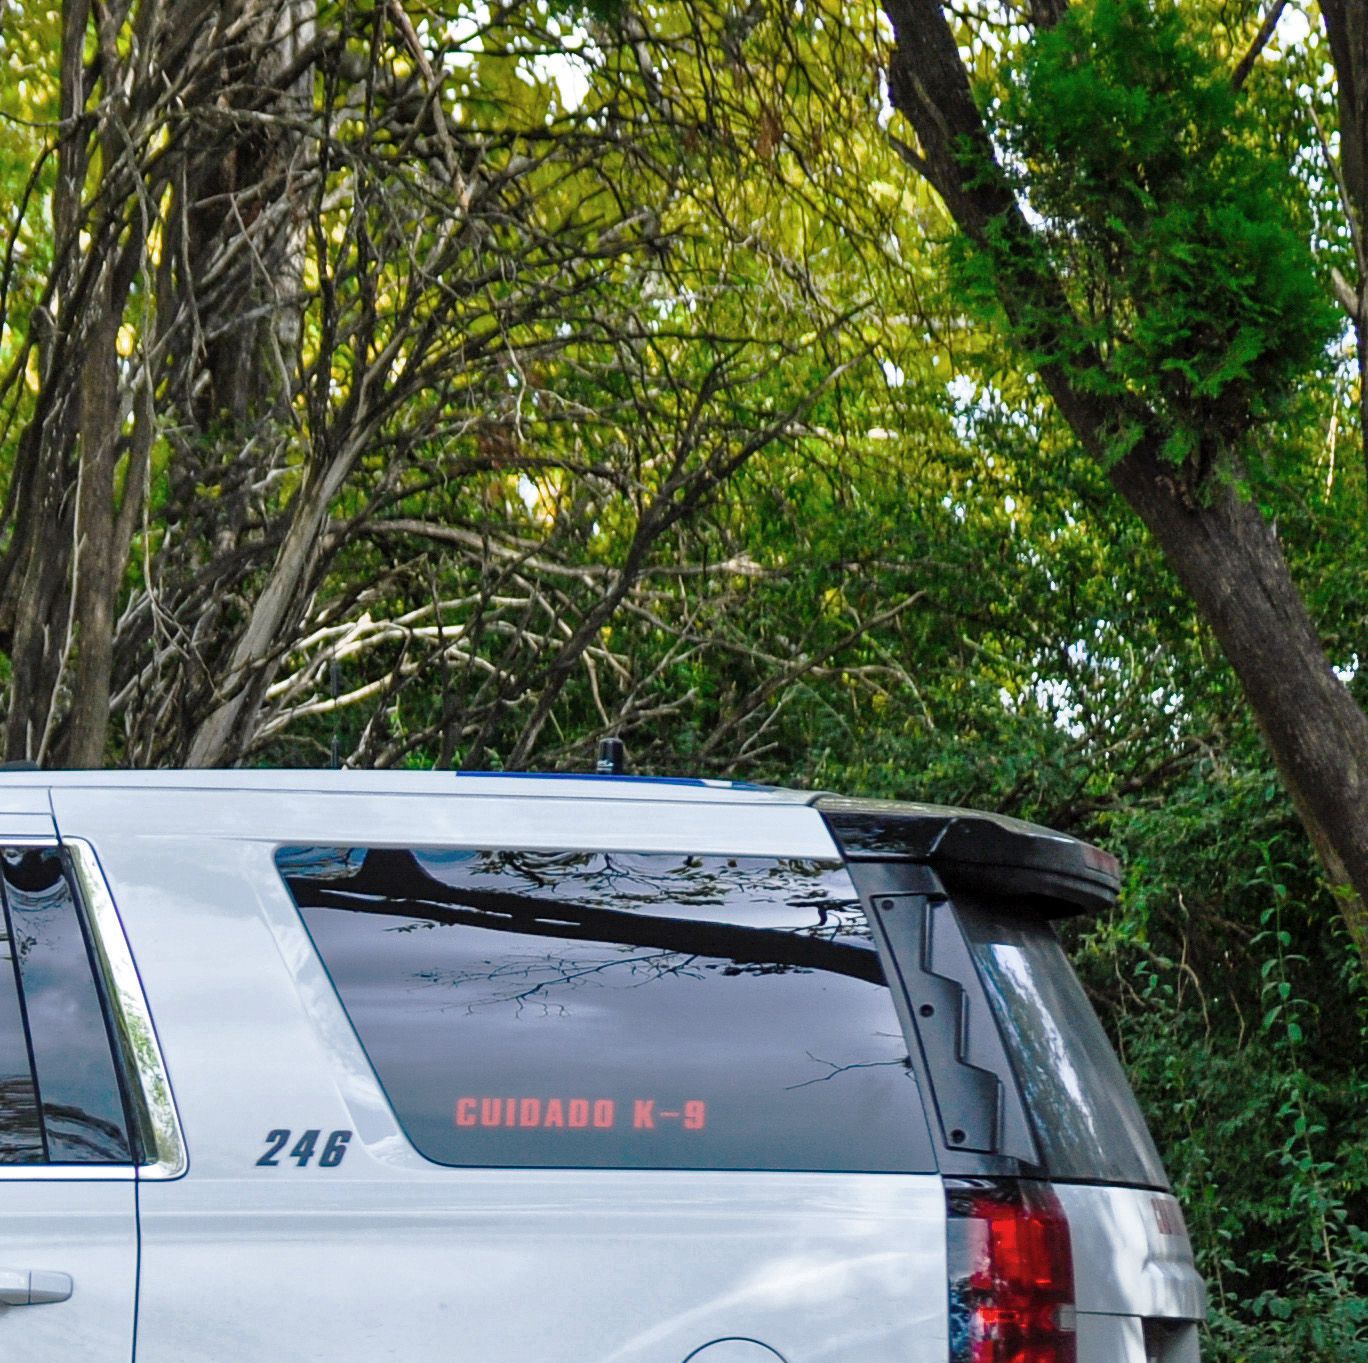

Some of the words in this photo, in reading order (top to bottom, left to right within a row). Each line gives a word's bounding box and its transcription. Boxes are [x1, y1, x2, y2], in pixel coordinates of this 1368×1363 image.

[456, 1098, 614, 1127] CUIDADO
[634, 1100, 706, 1128] K-9
[255, 1129, 352, 1167] 246
